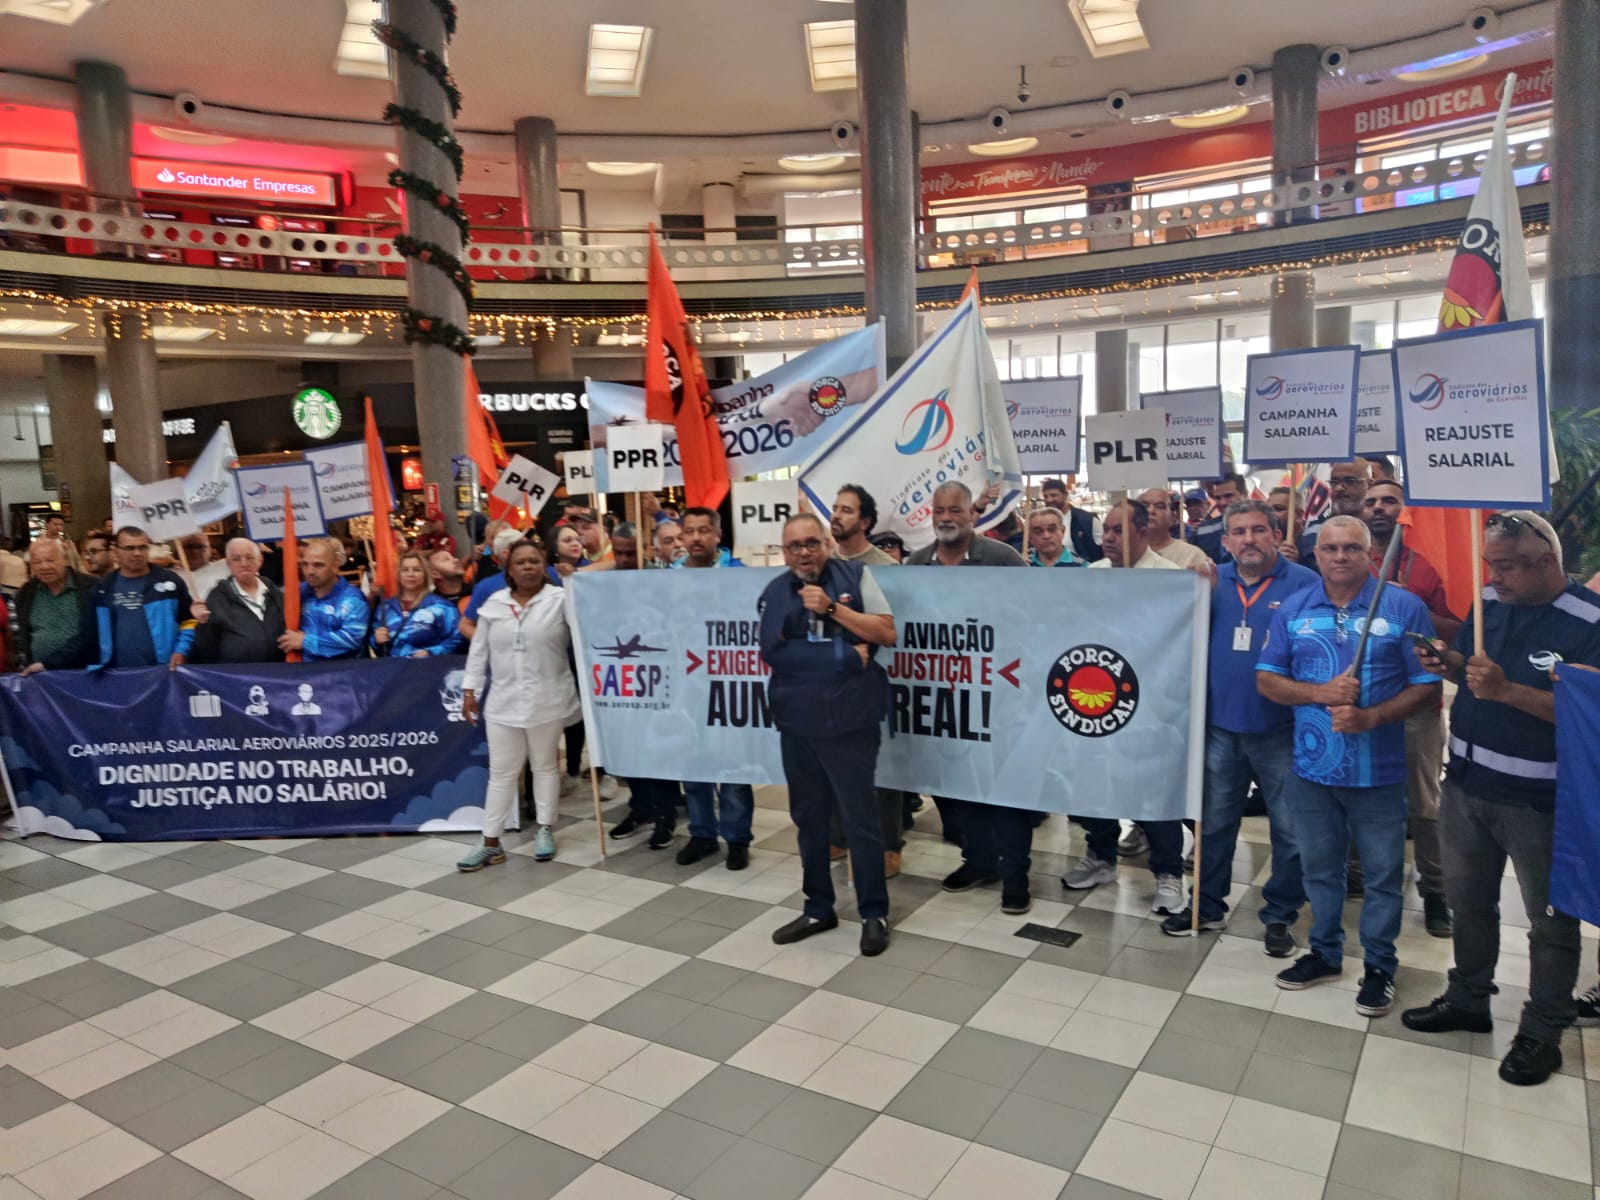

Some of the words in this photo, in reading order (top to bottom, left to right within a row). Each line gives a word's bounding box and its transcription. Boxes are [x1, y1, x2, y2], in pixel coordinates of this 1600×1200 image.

[1354, 85, 1486, 134] BIBLIOTECA
[177, 171, 249, 190] Santander
[253, 177, 316, 195] Empresas
[713, 384, 775, 414] panha
[1449, 383, 1528, 400] aeroviários
[1260, 408, 1338, 421] CAMPANHA
[1265, 426, 1330, 438] SALARIAL
[1425, 423, 1515, 441] REAJUSTE
[613, 449, 659, 469] PPR
[1094, 437, 1159, 464] PLR
[1428, 452, 1515, 468] SALARIAL
[506, 471, 546, 501] PLR
[570, 466, 594, 480] PL
[142, 499, 188, 522] PPR
[741, 503, 791, 524] PLR
[904, 617, 994, 661] AVIAÇÃO
[887, 652, 973, 693] JUSTIÇA
[981, 656, 993, 686] E
[1058, 647, 1125, 678] FORÇA
[592, 663, 662, 697] SAESP
[891, 684, 992, 742] REAL!
[1049, 693, 1136, 734] SINDICAL
[68, 741, 165, 758] CAMPANHA
[166, 738, 241, 753] SALARIAL
[242, 733, 347, 751] AEROVIÁRIOS
[348, 731, 440, 749] 2025/2026
[99, 761, 235, 785] DIGNIDADE
[238, 760, 275, 780] NO
[277, 756, 416, 778] TRABALHO,
[130, 785, 234, 810] JUSTIÇA
[236, 784, 273, 804] NO
[276, 779, 388, 804] SALÁRIO!
